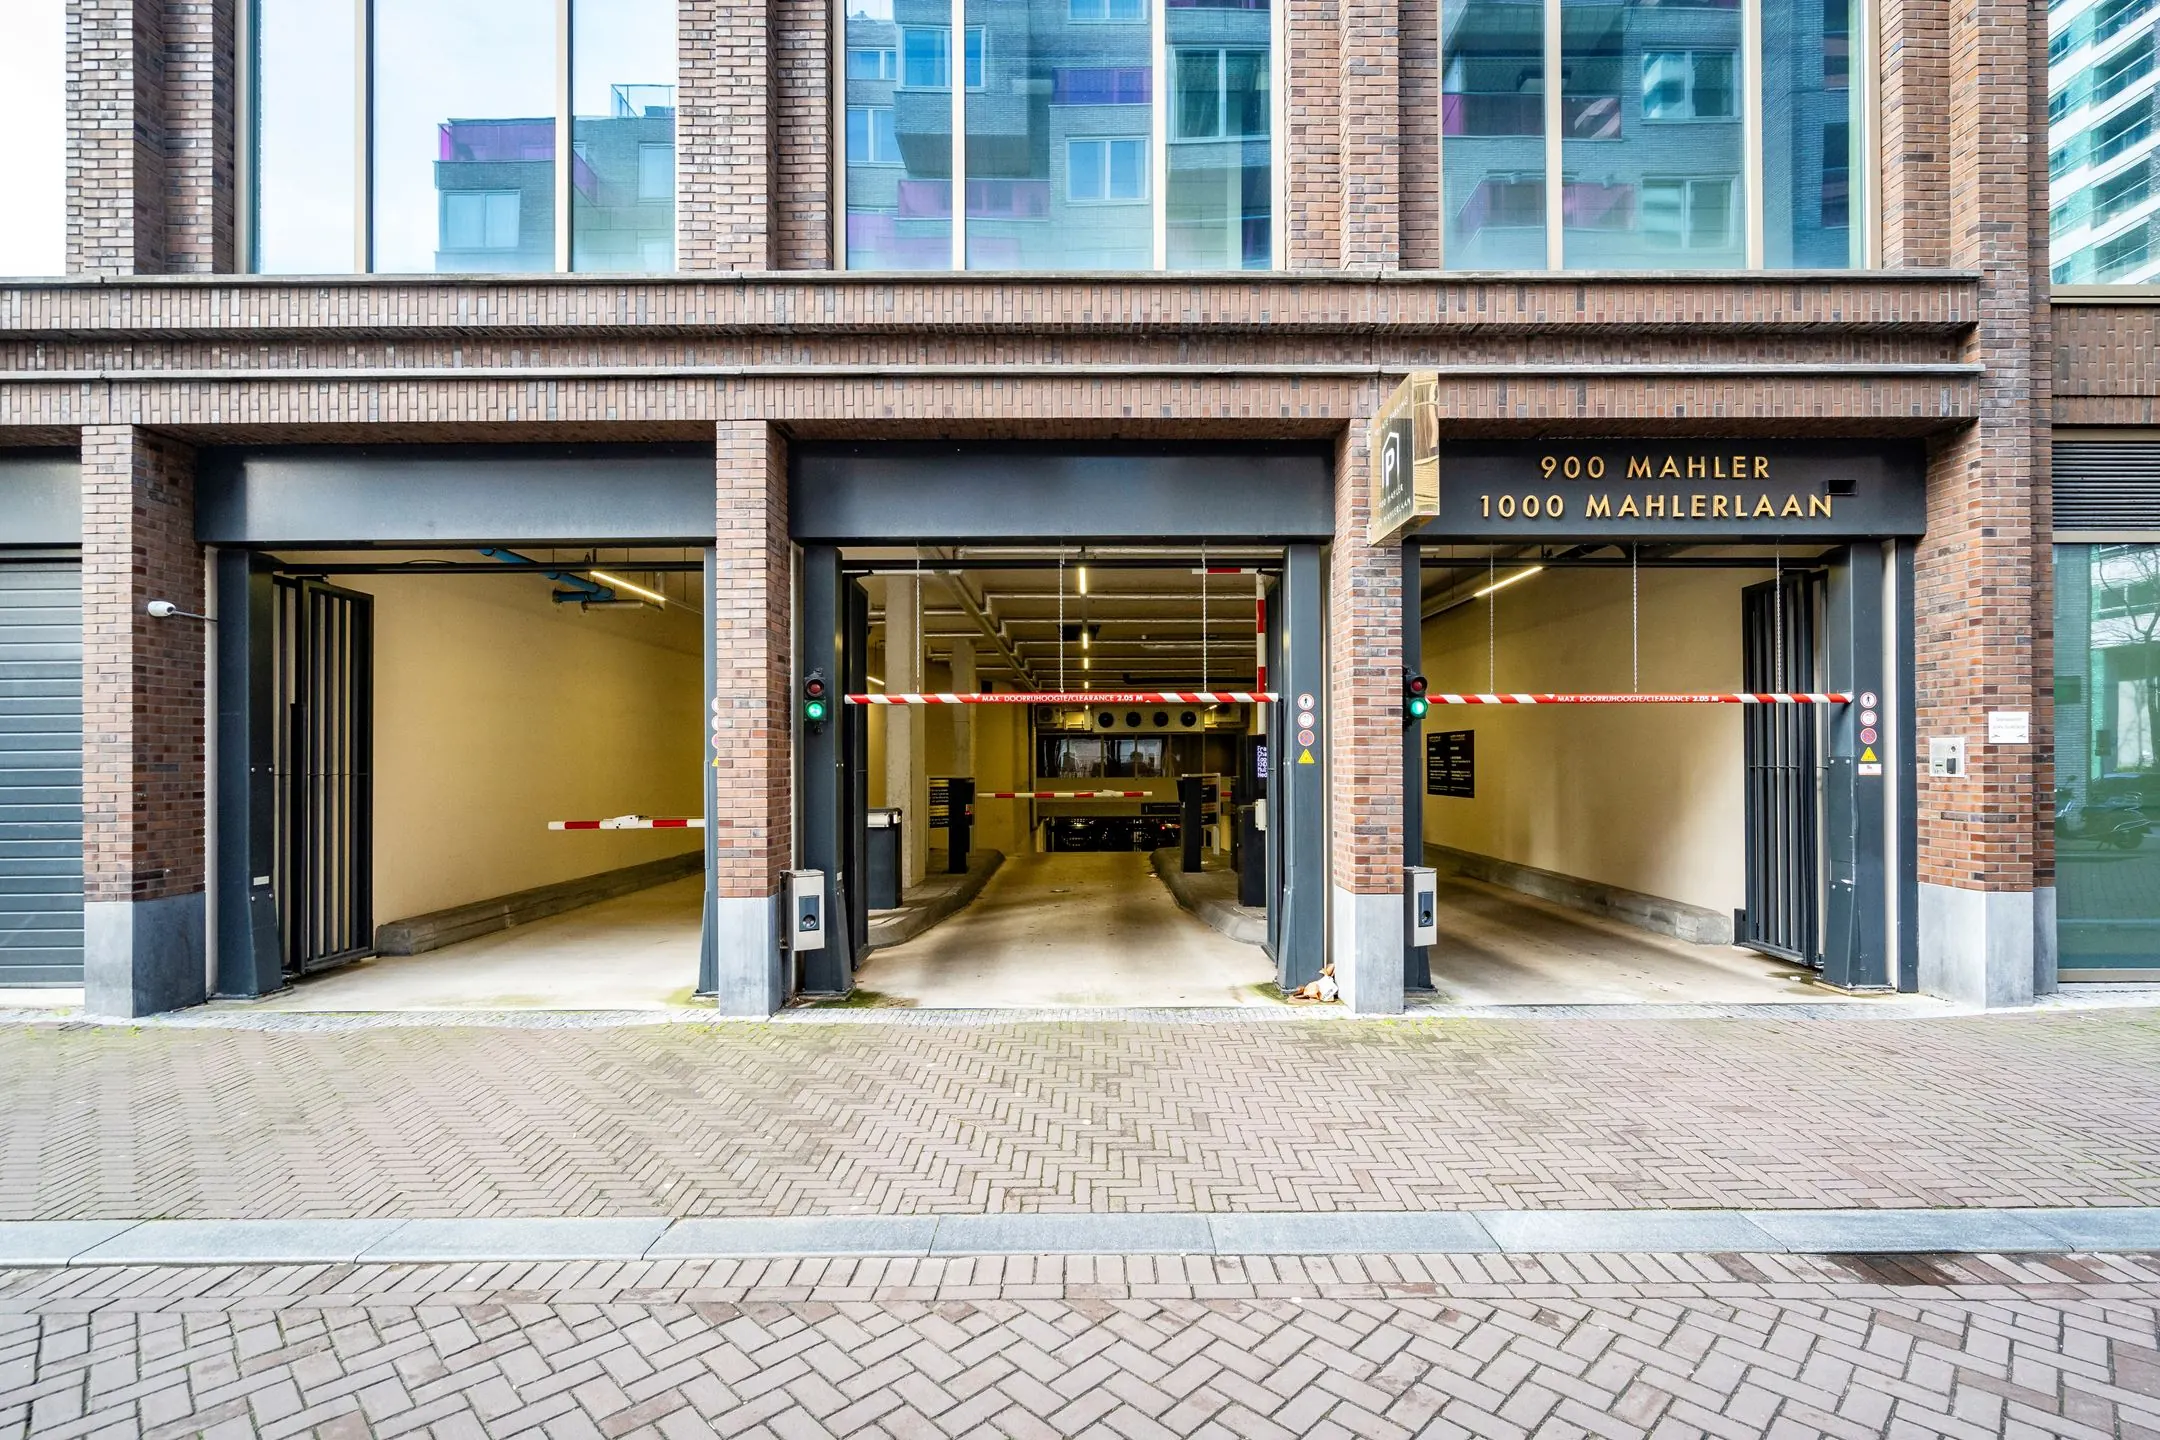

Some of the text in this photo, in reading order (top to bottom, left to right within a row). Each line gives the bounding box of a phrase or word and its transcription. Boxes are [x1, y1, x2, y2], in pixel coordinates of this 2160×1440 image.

[1385, 448, 1395, 487] P
[1541, 455, 1769, 479] 900 MAHLER
[1480, 494, 1832, 518] 1000 MAHLERLAAN
